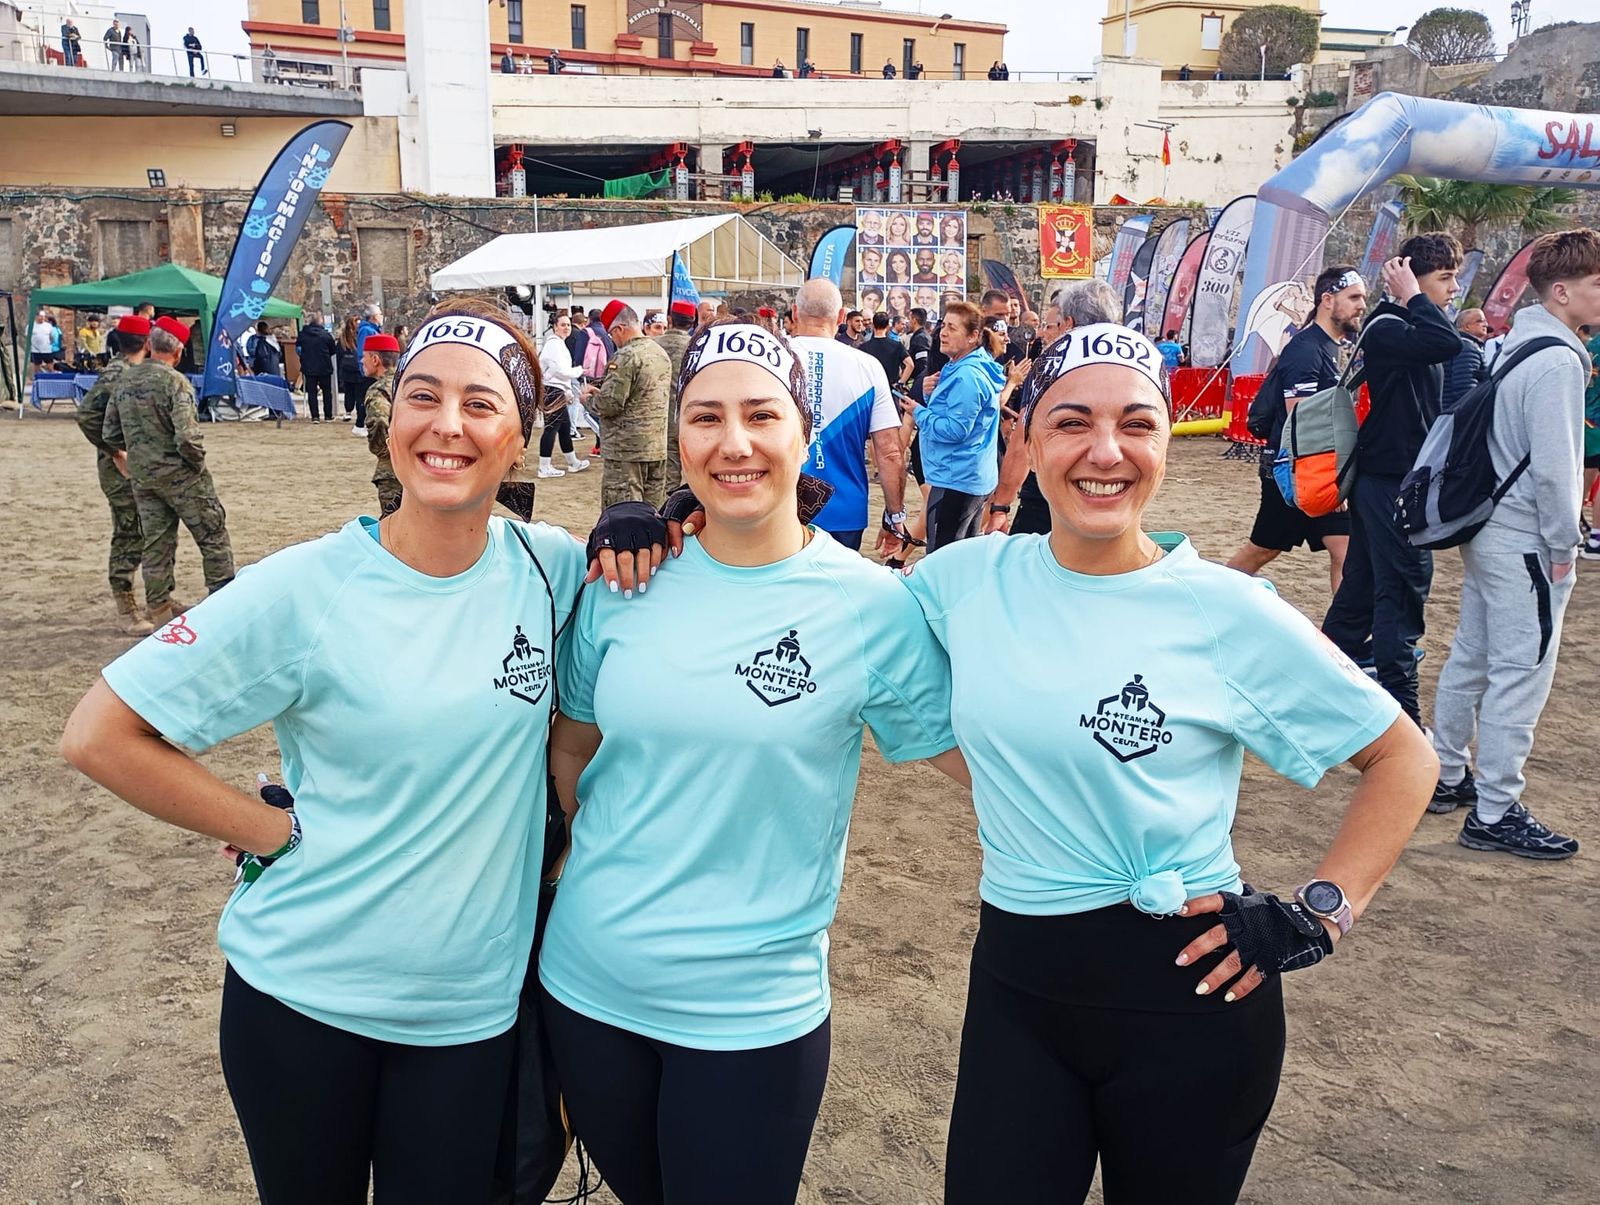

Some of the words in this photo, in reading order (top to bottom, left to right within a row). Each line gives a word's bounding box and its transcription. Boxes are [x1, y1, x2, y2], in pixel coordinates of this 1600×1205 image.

[628, 7, 660, 25] MERCADO
[671, 9, 701, 32] CENTRAL
[253, 143, 320, 279] INFORMACION
[822, 244, 835, 281] CEUTA
[1201, 279, 1230, 295] 300
[423, 320, 486, 344] 1651
[717, 331, 781, 368] 1653
[1081, 332, 1151, 371] 1652
[813, 352, 824, 429] PREPARACIÓN
[815, 432, 825, 470] FÍSICA
[520, 662, 536, 671] TEAM
[735, 663, 817, 693] MONTERO
[772, 664, 791, 674] TEAM
[524, 683, 541, 692] CEUTA
[762, 684, 786, 695] CEUTA
[1079, 714, 1173, 744] MONTERO
[1119, 713, 1142, 723] TEAM
[1112, 737, 1139, 748] CEUTA
